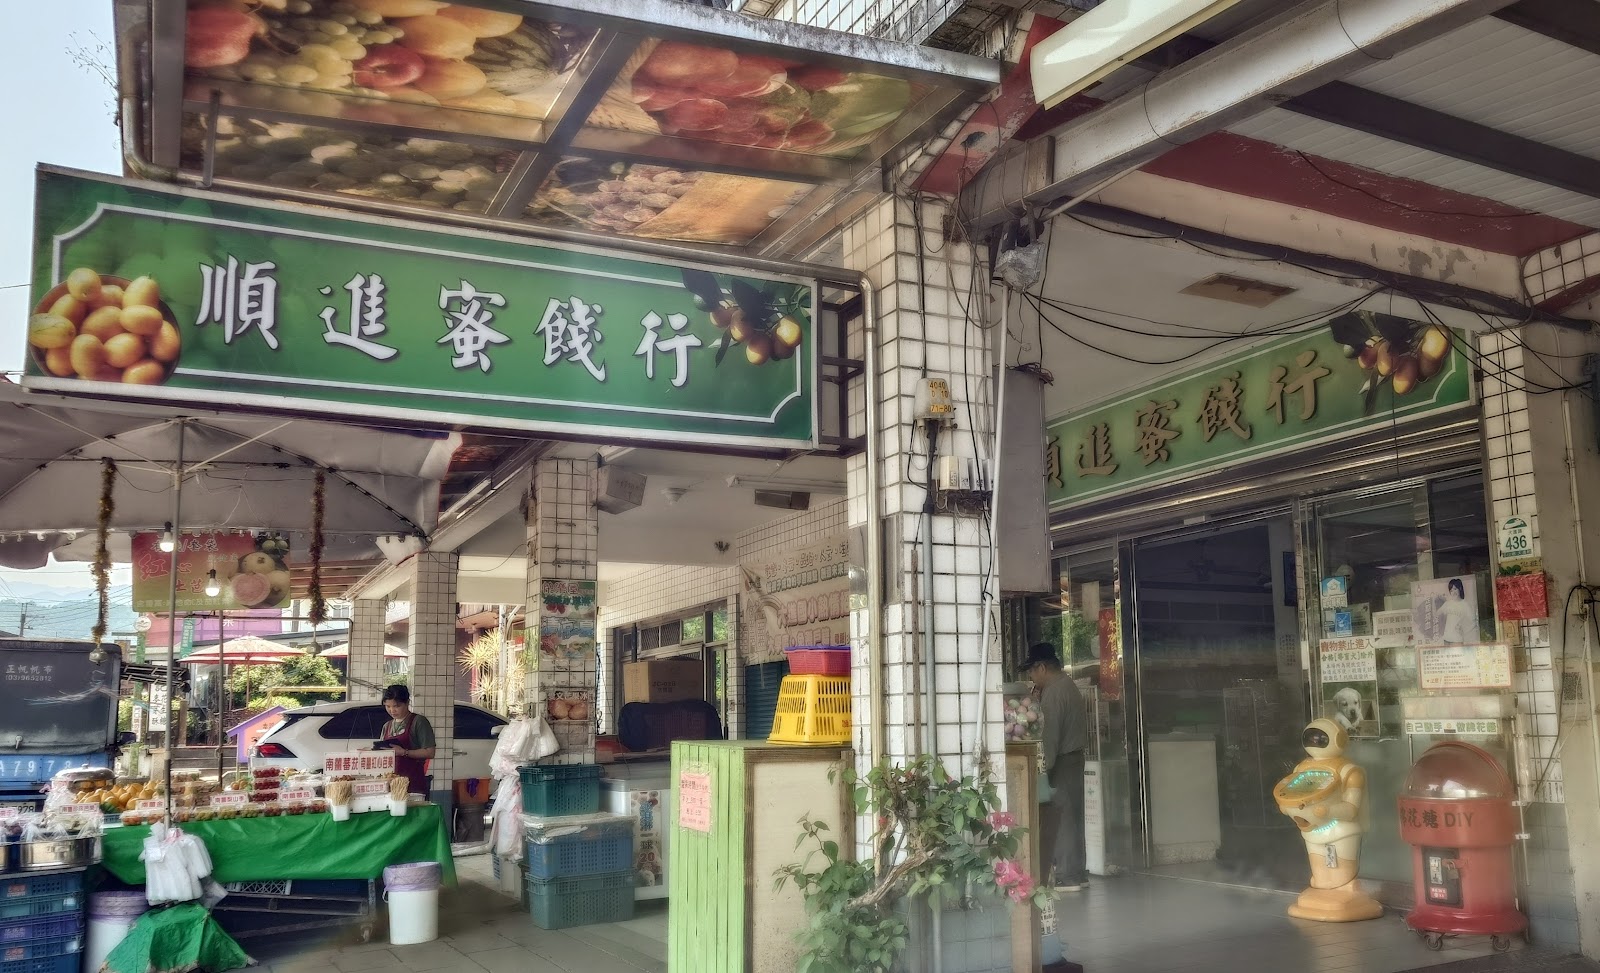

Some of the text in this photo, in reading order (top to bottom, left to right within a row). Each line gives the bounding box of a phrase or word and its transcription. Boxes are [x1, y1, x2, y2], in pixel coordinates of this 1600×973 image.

[195, 253, 703, 388] 順進蜜餞行
[1505, 535, 1527, 550] 436
[1321, 638, 1374, 653] 寵物禁止進入
[1406, 721, 1442, 733] 自己動手
[1444, 811, 1474, 828] DIY
